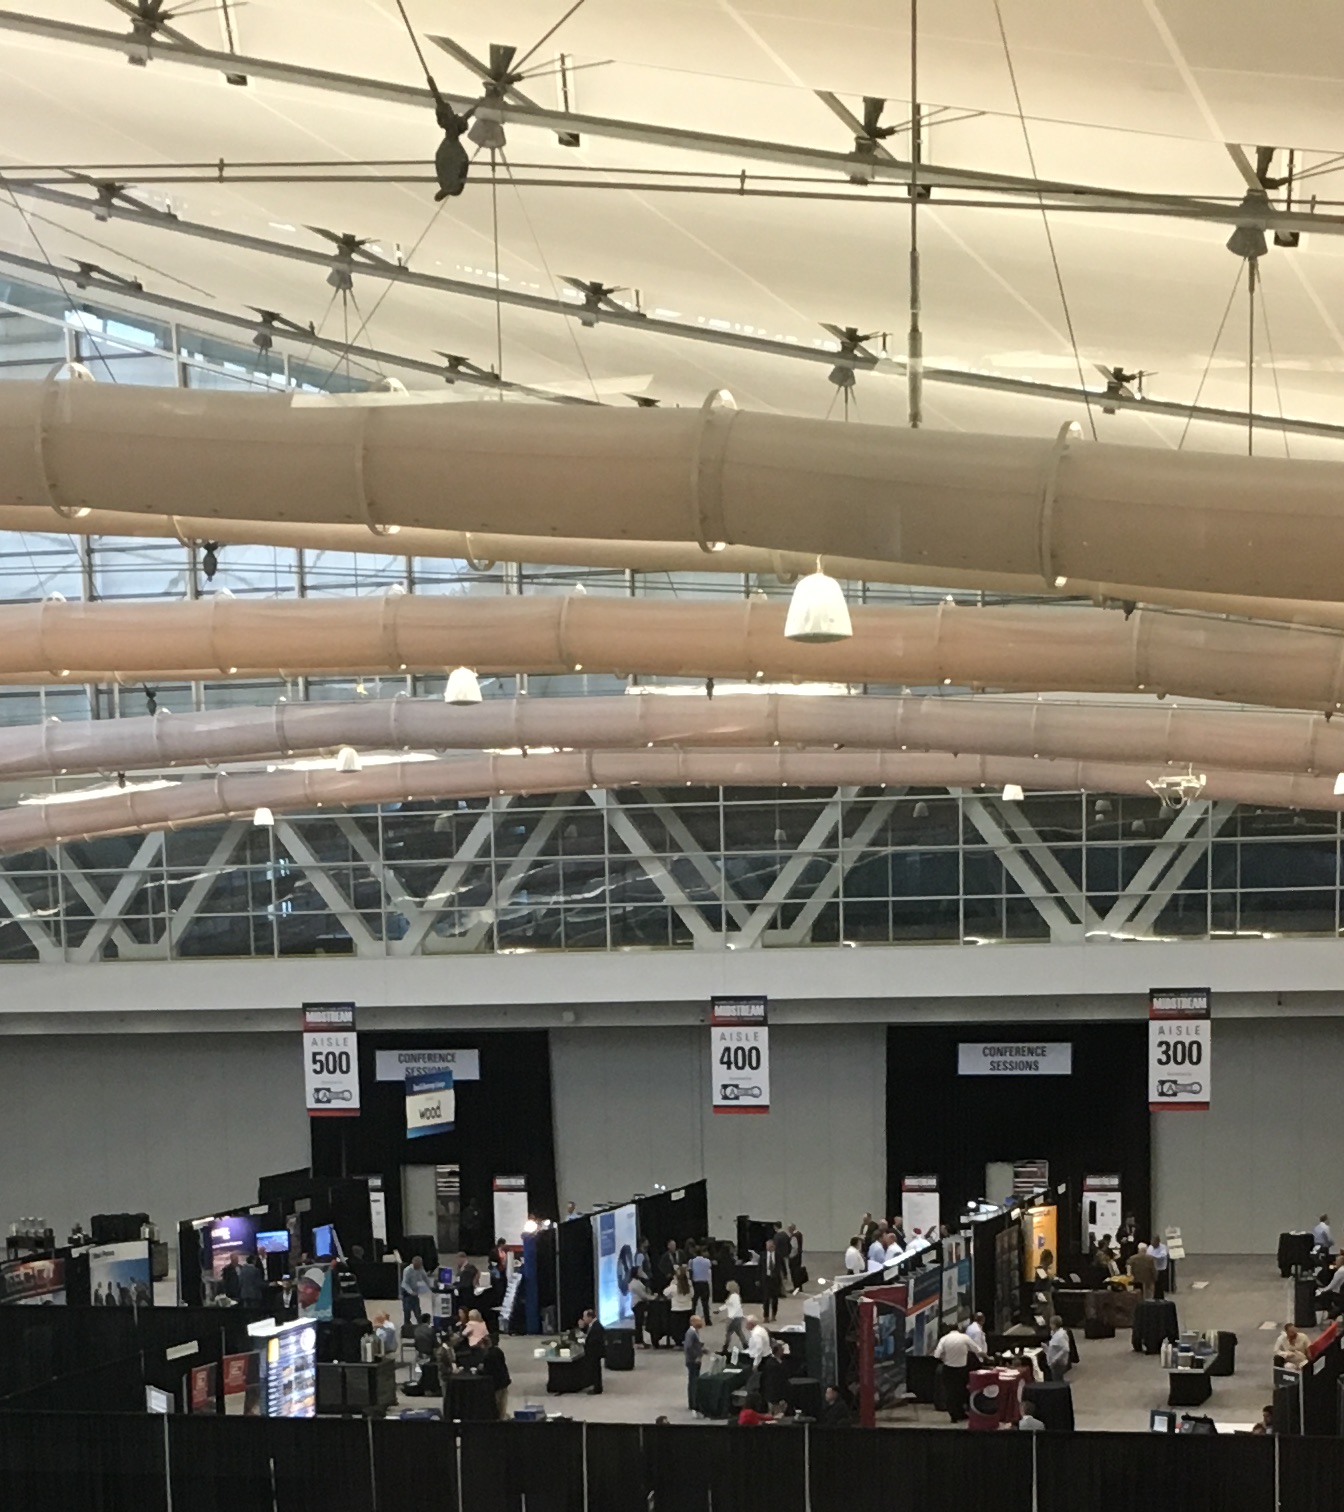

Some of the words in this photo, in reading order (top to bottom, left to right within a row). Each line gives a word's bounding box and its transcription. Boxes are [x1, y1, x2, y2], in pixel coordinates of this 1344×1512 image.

[1158, 1025, 1200, 1035] AISLE
[311, 1037, 348, 1046] AISLE
[720, 1031, 759, 1041] AISLE
[982, 1045, 1047, 1057] CONFERENCE
[1156, 1040, 1202, 1065] 300
[312, 1051, 350, 1074] 500
[398, 1052, 456, 1063] CONFERENCE
[719, 1045, 760, 1070] 400
[989, 1060, 1039, 1071] SESSIONS
